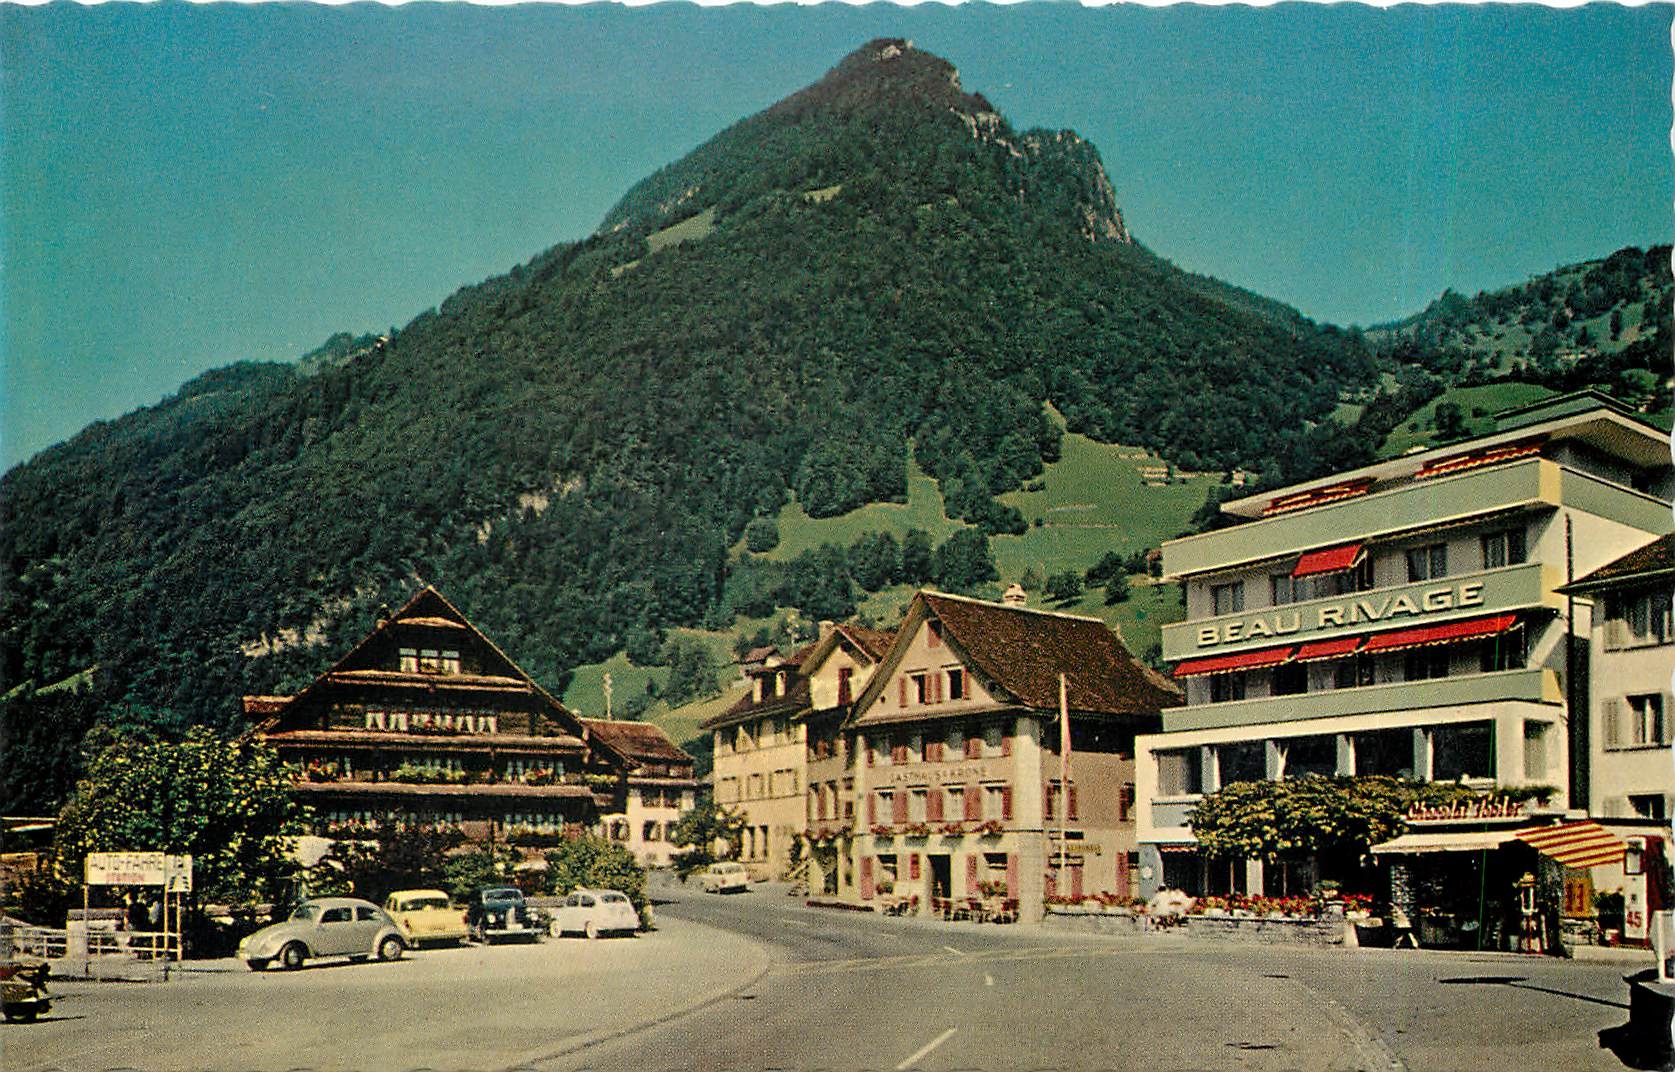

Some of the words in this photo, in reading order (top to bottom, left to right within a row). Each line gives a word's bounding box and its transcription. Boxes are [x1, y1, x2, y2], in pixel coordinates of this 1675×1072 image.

[1197, 613, 1302, 648] BEAU
[1318, 582, 1486, 627] RIVAGE
[1625, 911, 1642, 928] 45
